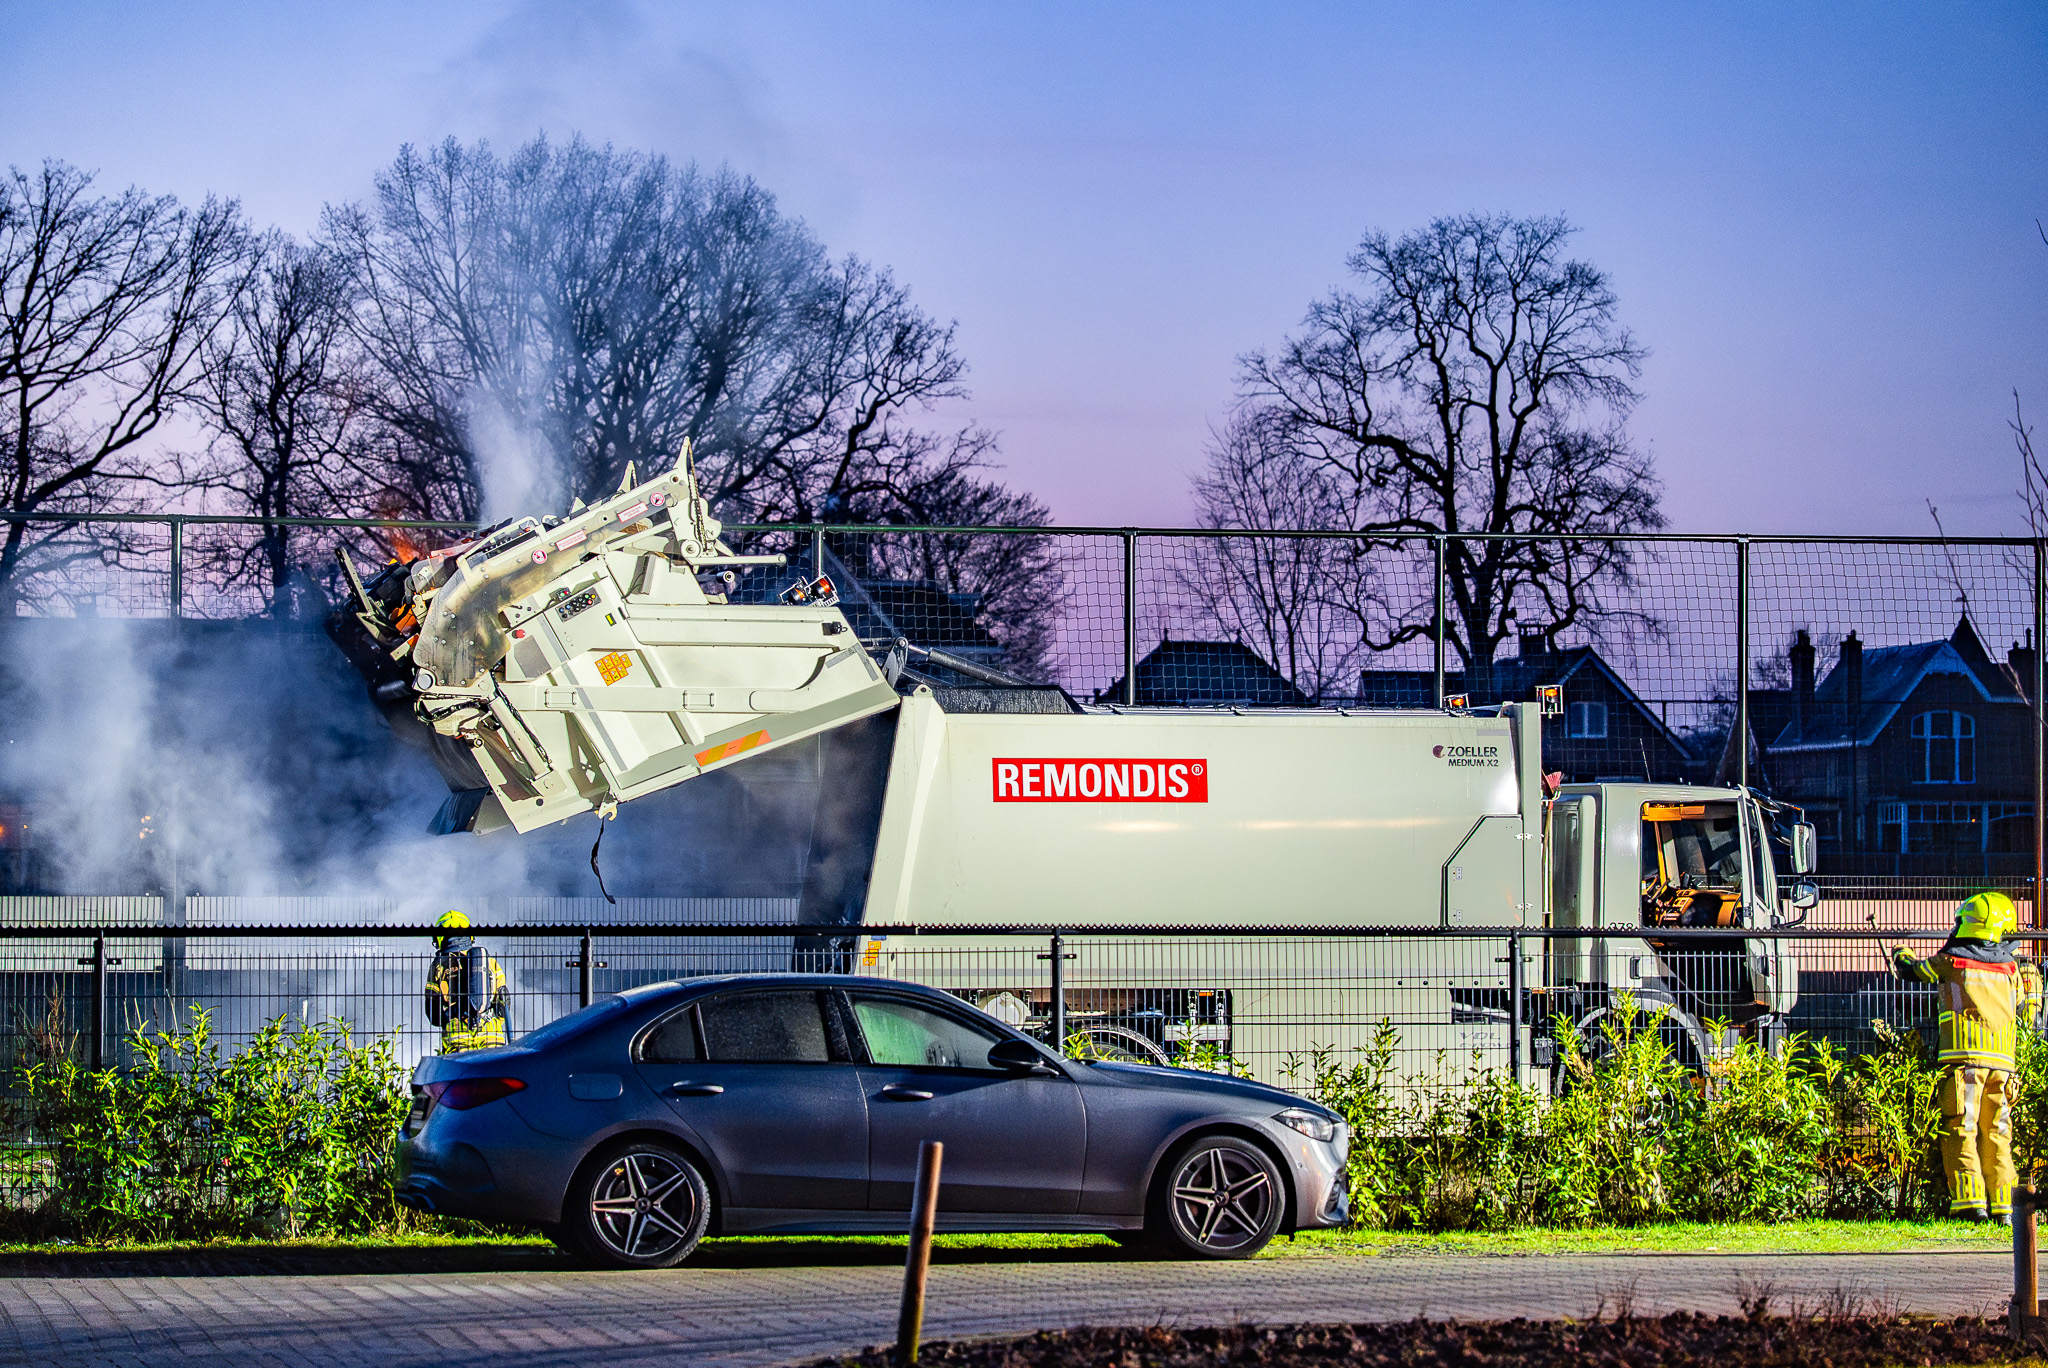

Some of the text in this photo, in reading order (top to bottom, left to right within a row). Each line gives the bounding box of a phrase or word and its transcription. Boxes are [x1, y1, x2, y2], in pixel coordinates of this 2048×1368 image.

[1447, 746, 1498, 758] ZOELLER
[1448, 759, 1499, 767] MEDIUM X2
